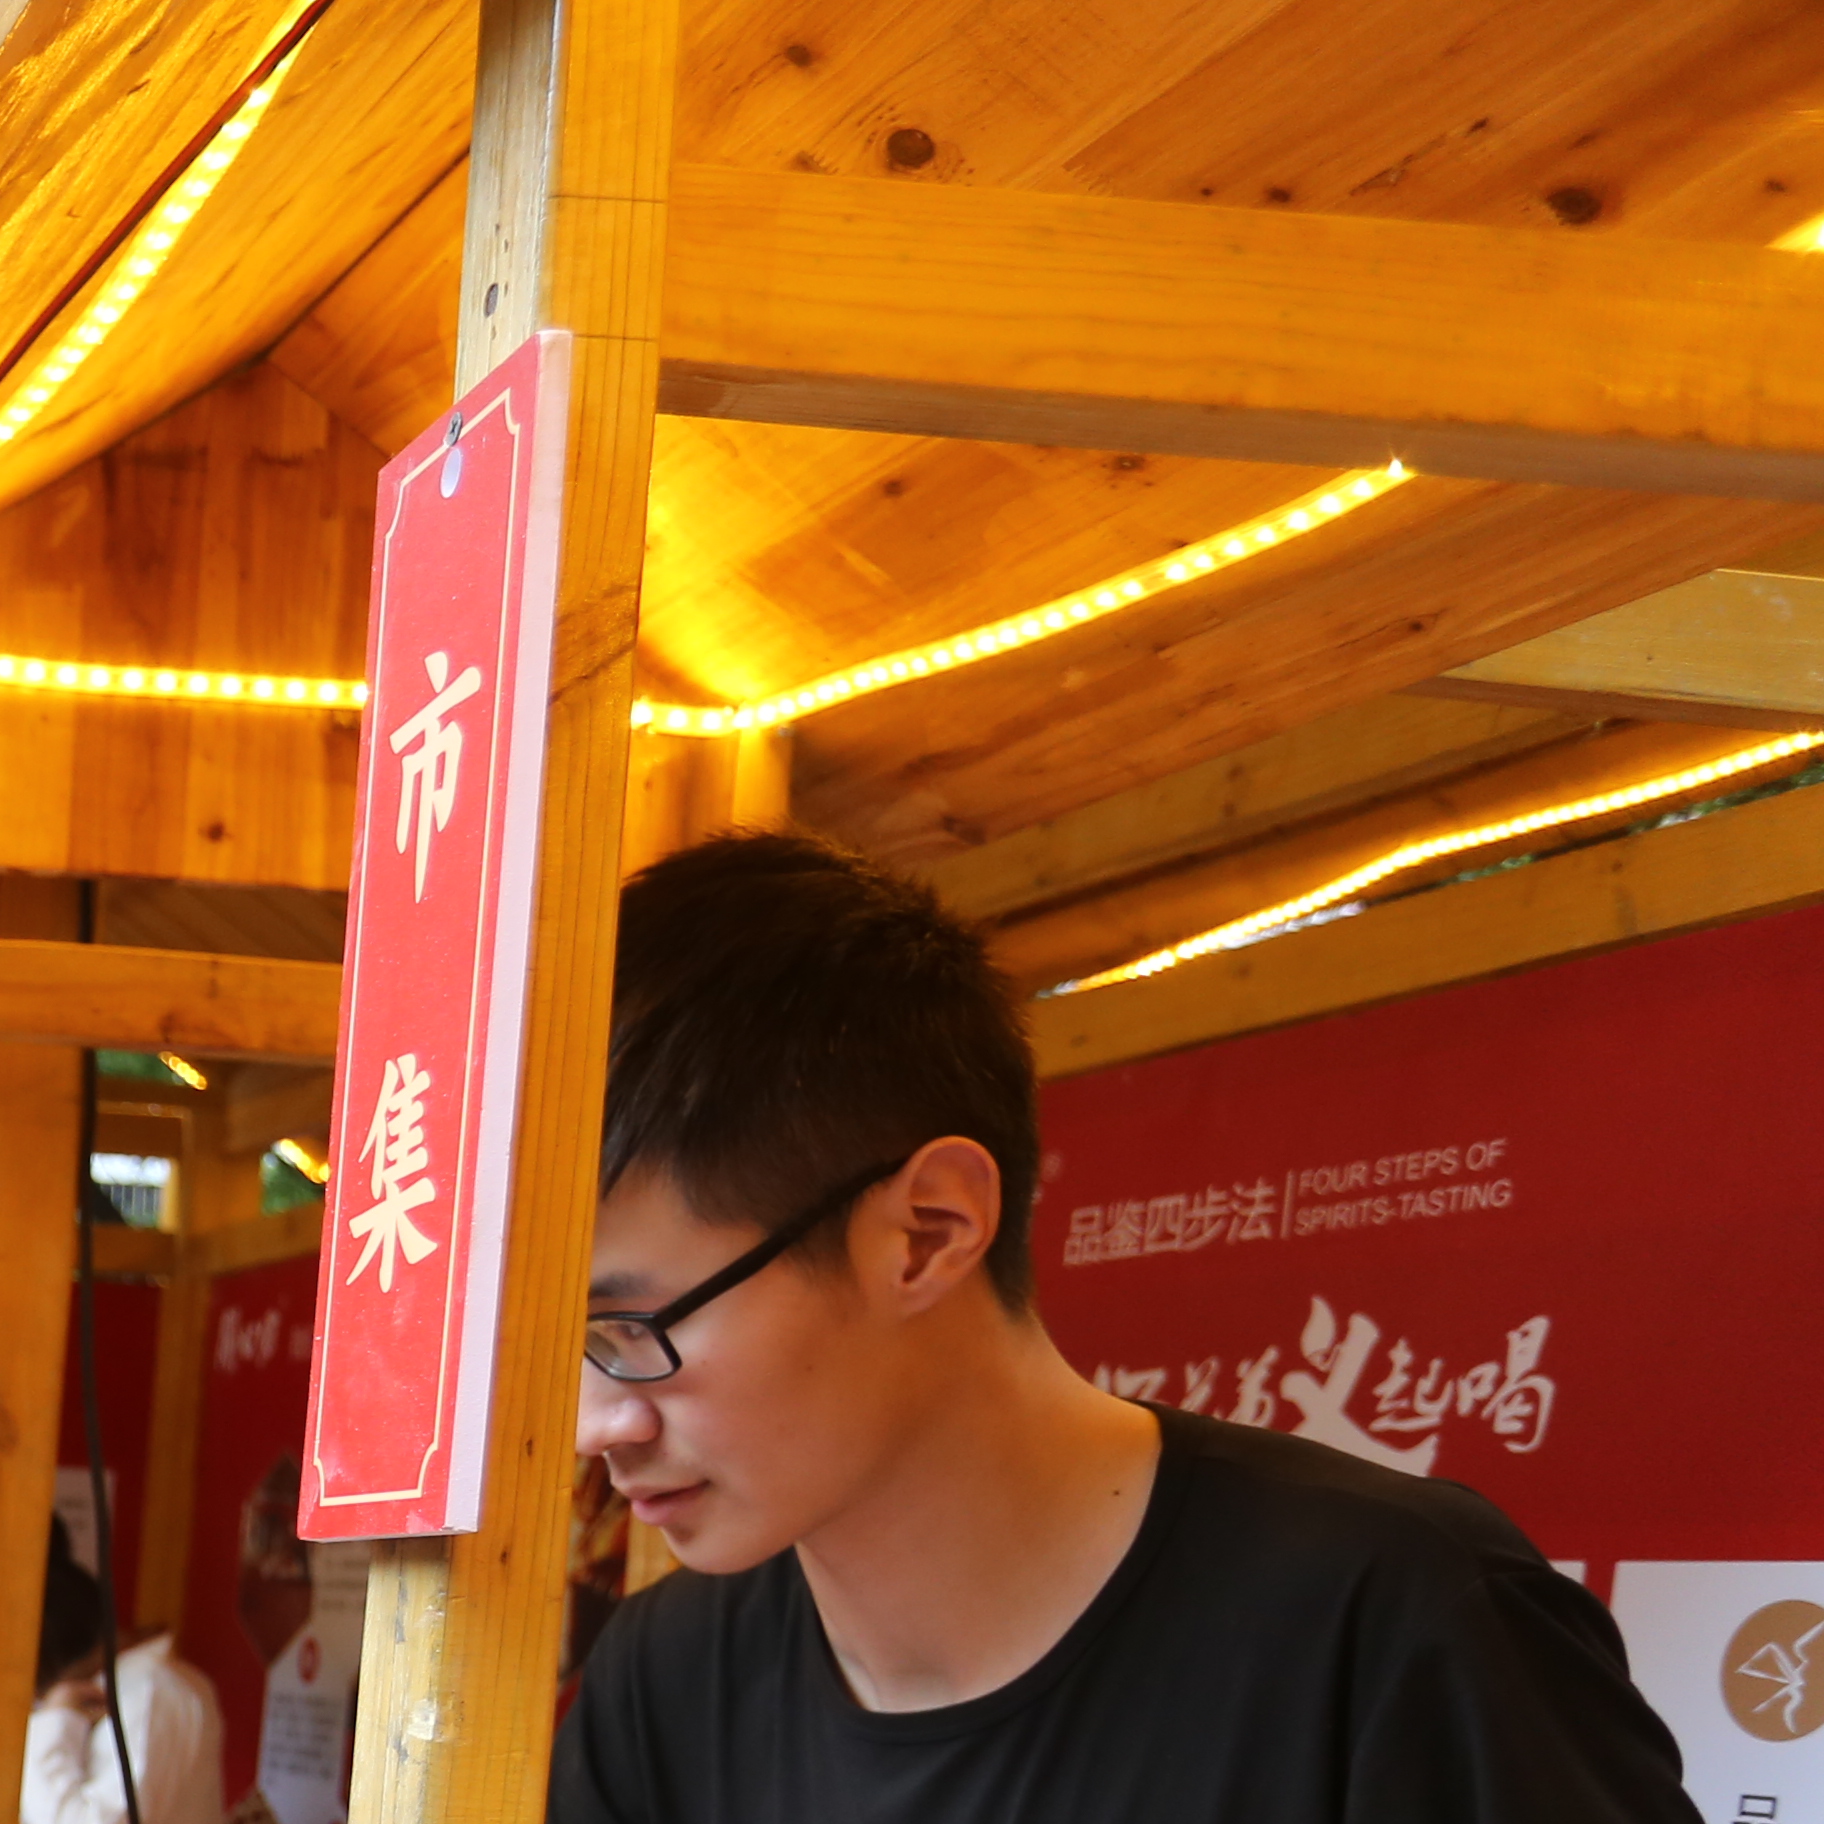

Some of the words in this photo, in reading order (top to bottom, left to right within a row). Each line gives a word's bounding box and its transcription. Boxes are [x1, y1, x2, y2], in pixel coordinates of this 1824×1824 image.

[346, 650, 482, 1293] 市集
[1298, 1159, 1367, 1197] FOUR
[1373, 1146, 1459, 1186] STEPS
[1465, 1137, 1508, 1172] OF
[1063, 1177, 1277, 1266] 品鉴四步法
[1292, 1178, 1514, 1237] SPIRITS-TASTING
